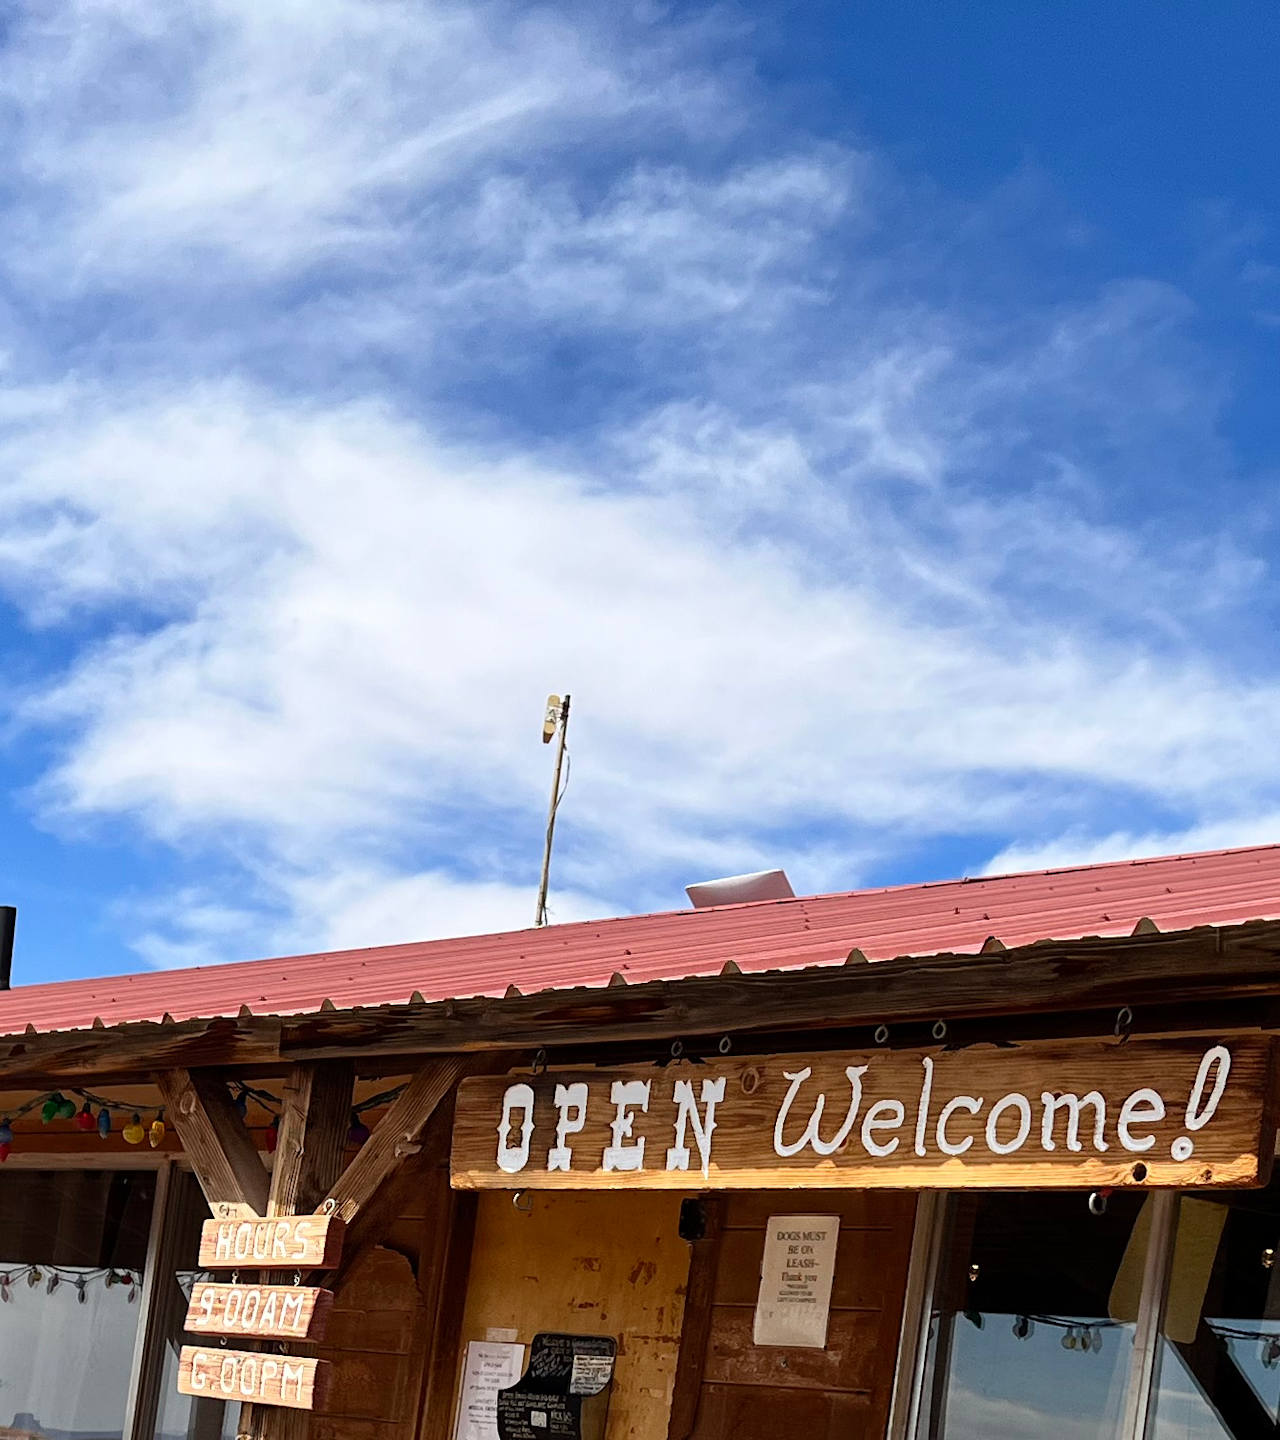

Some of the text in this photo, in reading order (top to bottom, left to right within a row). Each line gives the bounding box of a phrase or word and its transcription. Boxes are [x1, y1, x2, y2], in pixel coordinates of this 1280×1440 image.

[495, 1046, 1231, 1179] OPEN Welcome!
[215, 1221, 312, 1261] HOURS
[776, 1231, 827, 1241] DOGS MUST
